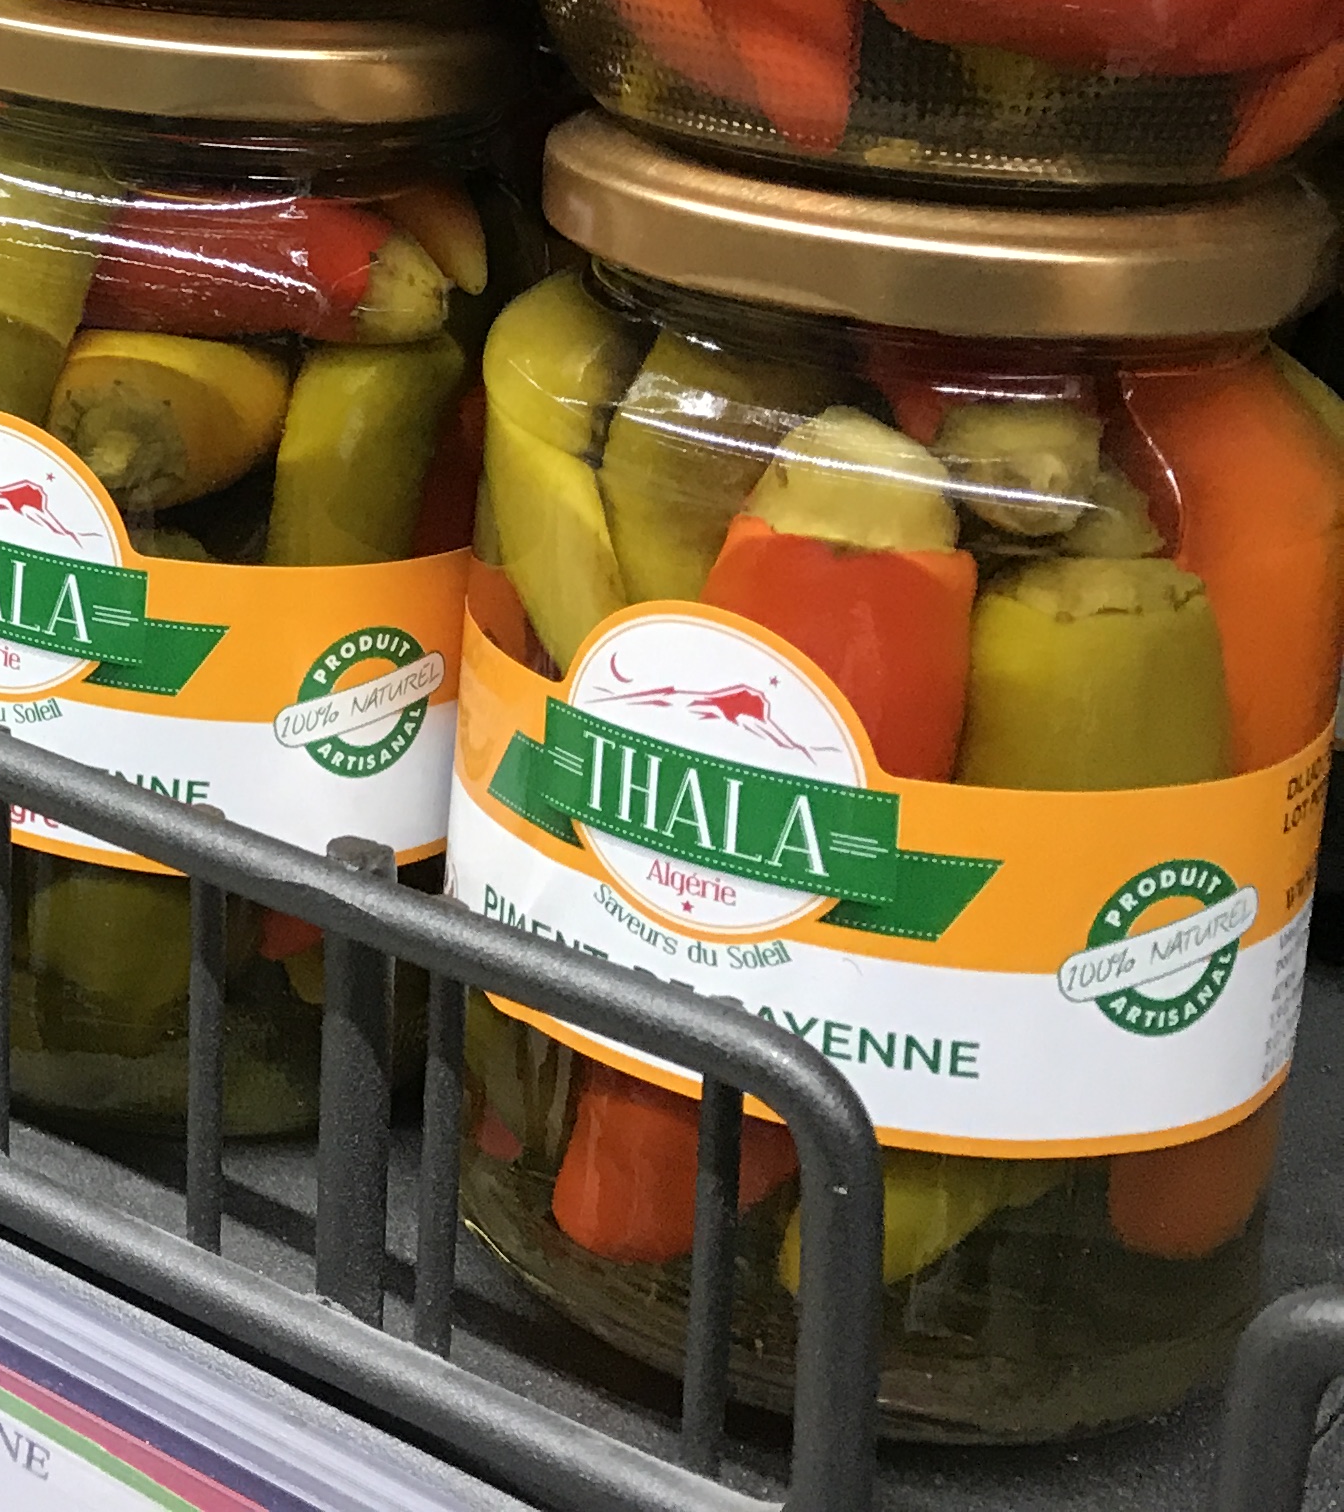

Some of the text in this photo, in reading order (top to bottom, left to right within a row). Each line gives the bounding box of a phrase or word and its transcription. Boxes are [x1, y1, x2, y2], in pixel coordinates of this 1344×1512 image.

[313, 633, 410, 684] PRODUIT
[14, 698, 63, 724] Soleil
[281, 662, 440, 738] 100% NATUREL
[317, 708, 421, 771] ARTISANAL
[583, 730, 831, 878] THALA
[646, 858, 737, 907] Algérie
[1104, 867, 1222, 927] PRODUIT
[593, 882, 794, 970] Saveurs du Soleil
[1068, 899, 1253, 991] 100% NATUREL
[1109, 952, 1232, 1028] ARTISANAL
